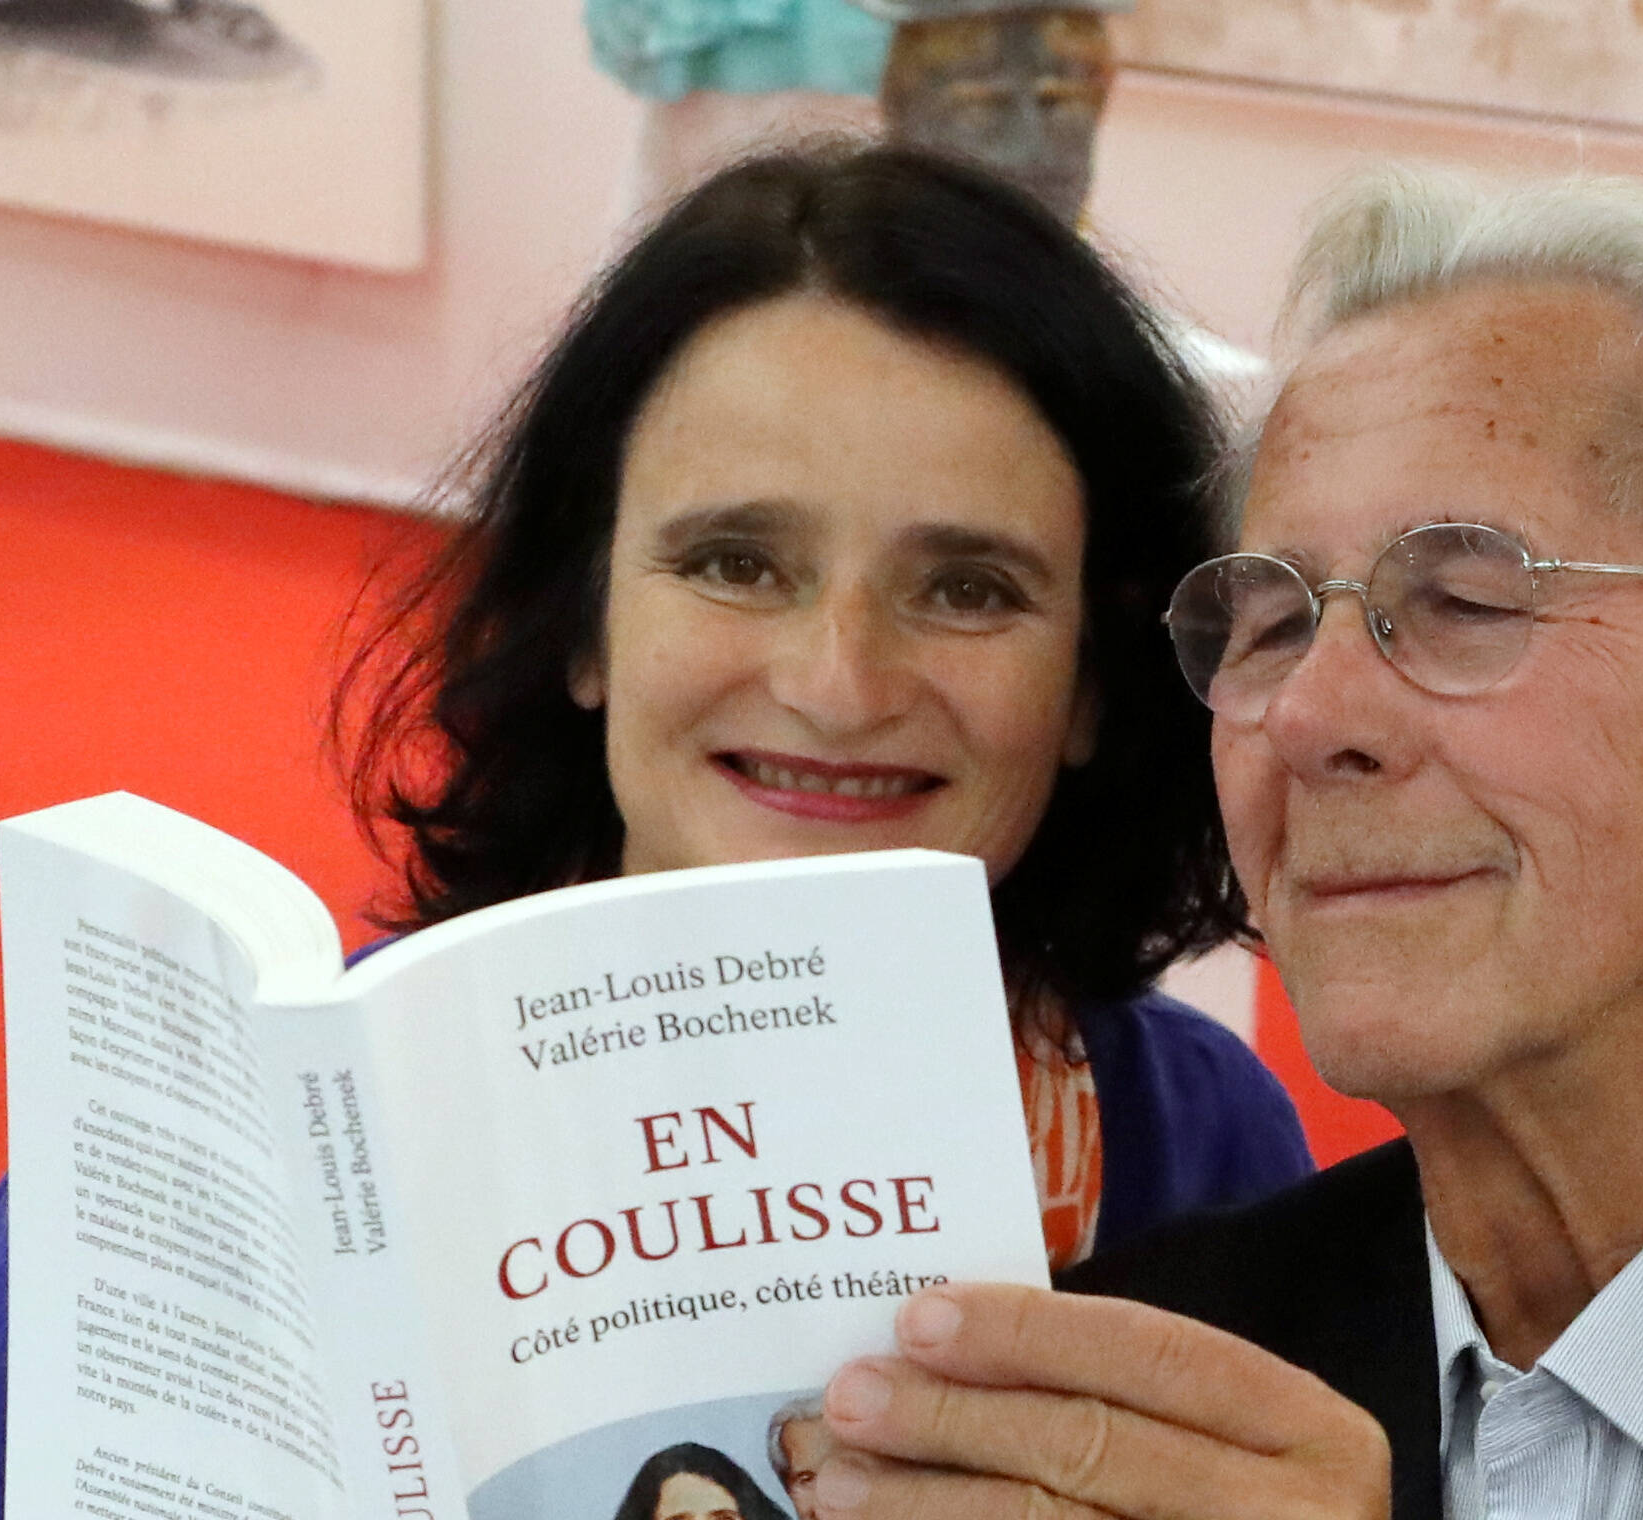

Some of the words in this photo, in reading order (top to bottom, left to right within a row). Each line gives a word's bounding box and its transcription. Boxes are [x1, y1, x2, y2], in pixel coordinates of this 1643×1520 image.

[514, 961, 706, 1029] Jean-Louis
[715, 946, 826, 986] Debré
[520, 1022, 647, 1072] Valérie
[657, 995, 837, 1044] Bochenek
[300, 1072, 331, 1138] Debré
[332, 1068, 373, 1175] Bochenek
[634, 1101, 760, 1174] EN
[321, 1143, 357, 1255] Jean-Louis
[360, 1179, 388, 1256] Valérie
[497, 1175, 941, 1301] COULISSE
[510, 1319, 581, 1365] Côté
[589, 1287, 748, 1343] politique,
[755, 1272, 823, 1305] côté
